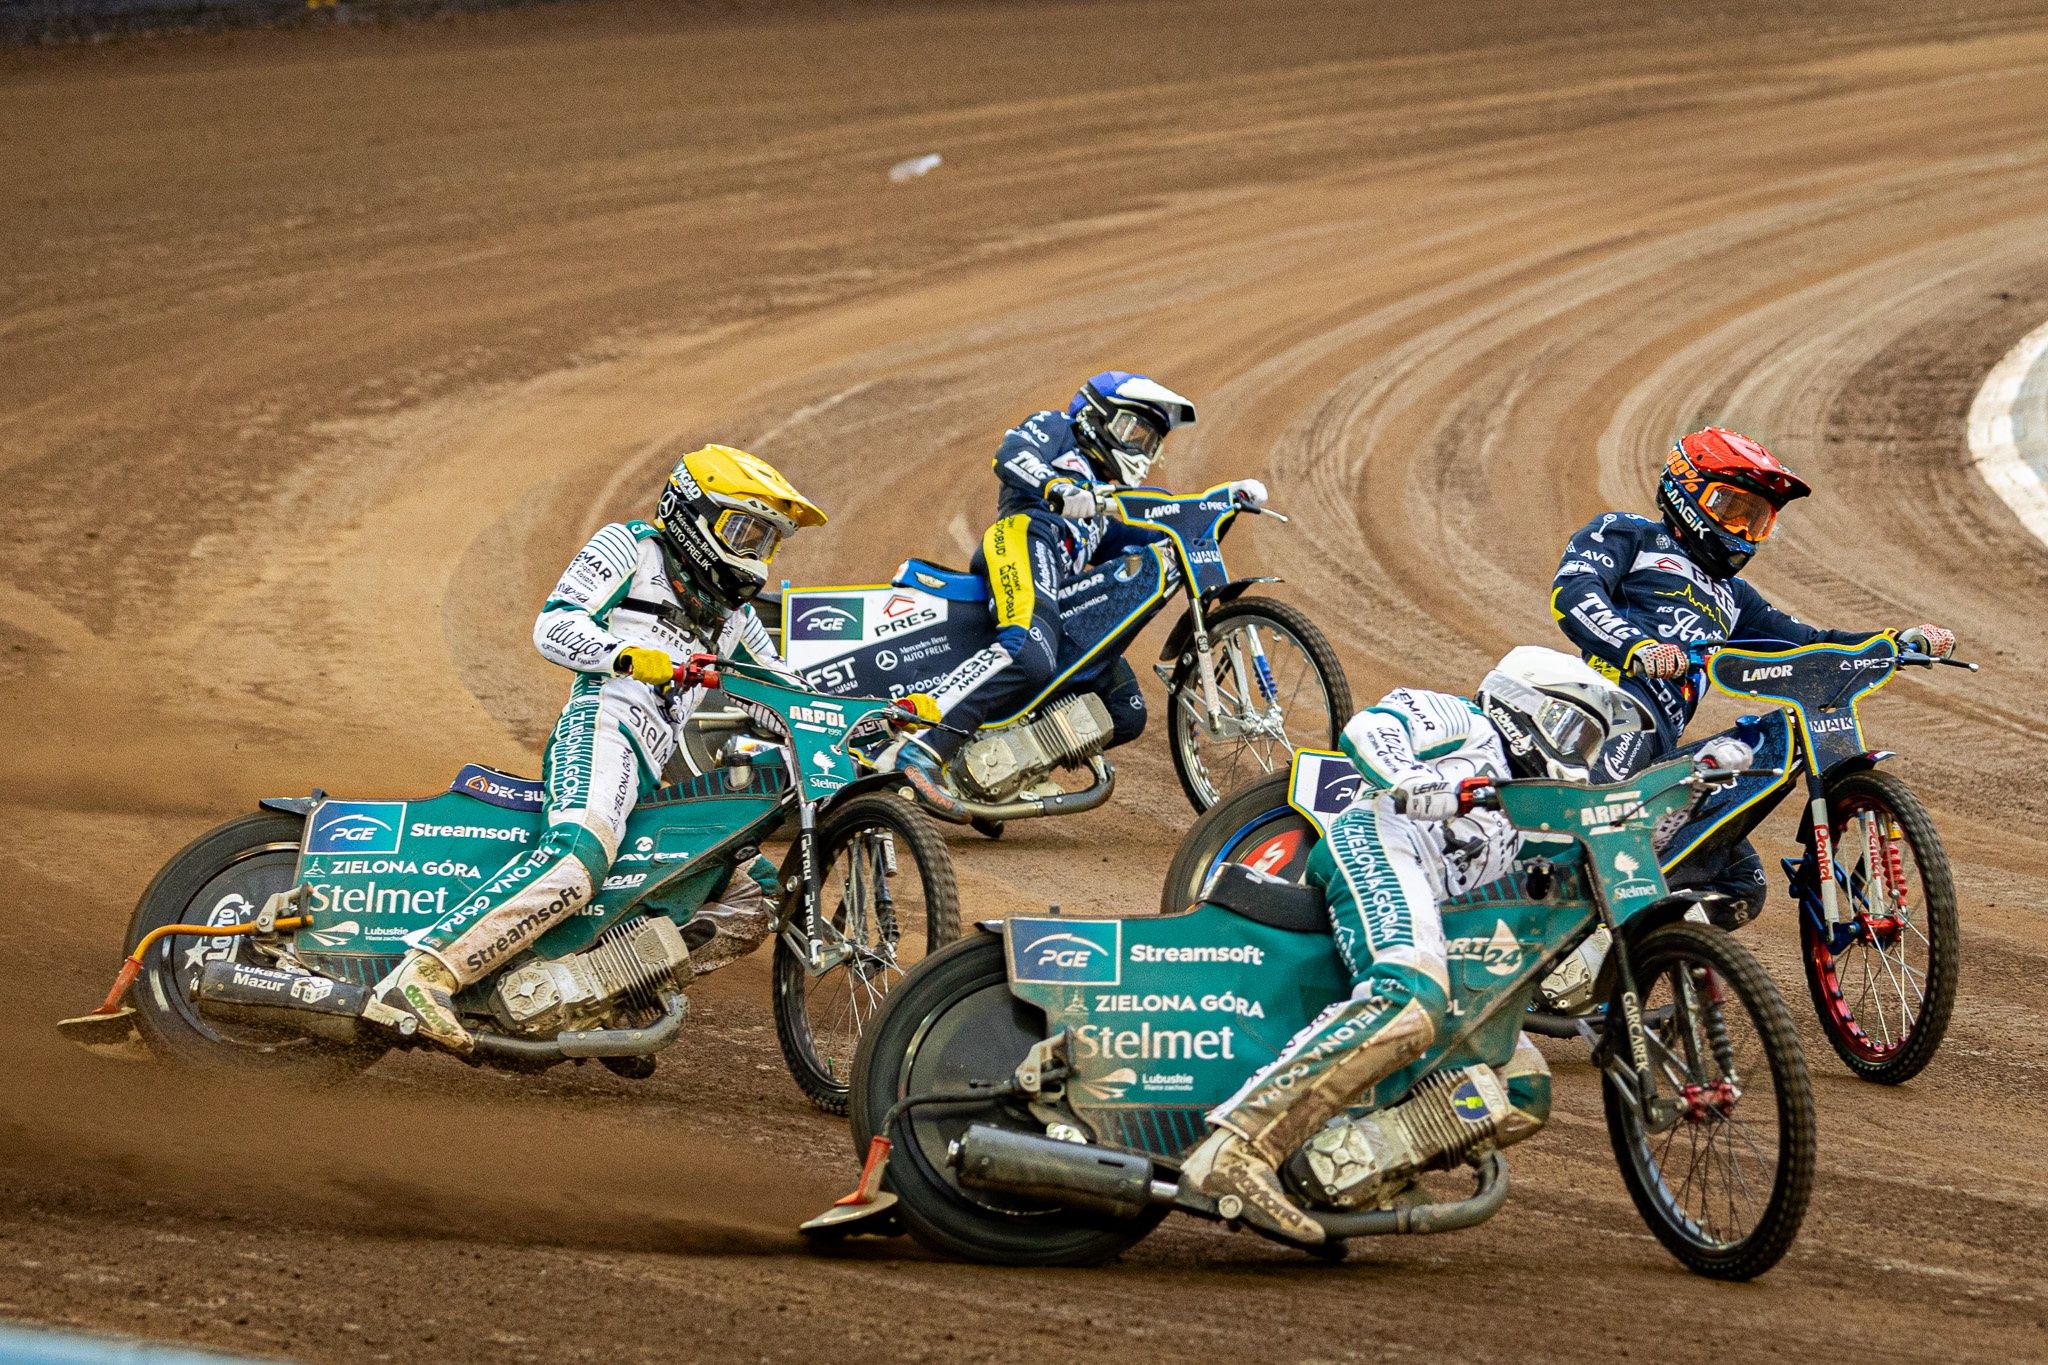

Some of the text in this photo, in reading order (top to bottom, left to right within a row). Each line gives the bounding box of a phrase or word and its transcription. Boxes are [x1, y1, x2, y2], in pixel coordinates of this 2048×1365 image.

[1144, 503, 1180, 519] LAVOR
[668, 520, 686, 543] AUTO
[683, 541, 712, 571] FRELIK
[674, 510, 719, 562] Mercedes-Benz
[1580, 549, 1615, 569] AVO
[807, 617, 846, 631] PGE
[874, 608, 937, 637] PRES
[903, 643, 952, 664] AUTO FRELIK
[1853, 657, 1893, 670] PRES
[806, 656, 856, 689] FST
[958, 665, 988, 692] DOMY
[1742, 664, 1794, 682] LAVOR
[789, 705, 847, 729] ARPOL
[1811, 717, 1854, 732] MAK
[1580, 803, 1650, 826] ARPOL
[330, 827, 377, 841] PGE
[410, 823, 529, 844] Streamsoft
[331, 858, 481, 879] ZIELONA GÓRA
[1344, 826, 1383, 890] ZIELONA
[310, 882, 449, 915] Stelmet
[1613, 884, 1657, 900] Stelmet
[364, 926, 409, 937] Lubuskie
[466, 885, 584, 973] Streamsoft
[1038, 950, 1091, 968] PGE
[1130, 944, 1265, 965] Streamsoft
[1484, 948, 1522, 966] 24
[233, 973, 285, 992] Mazur
[1095, 991, 1265, 1018] ZIELONA GÓRA
[1076, 1022, 1235, 1060] Stelmet
[1622, 991, 1649, 1072] GARCAREK
[1142, 1072, 1194, 1084] Lubuskie
